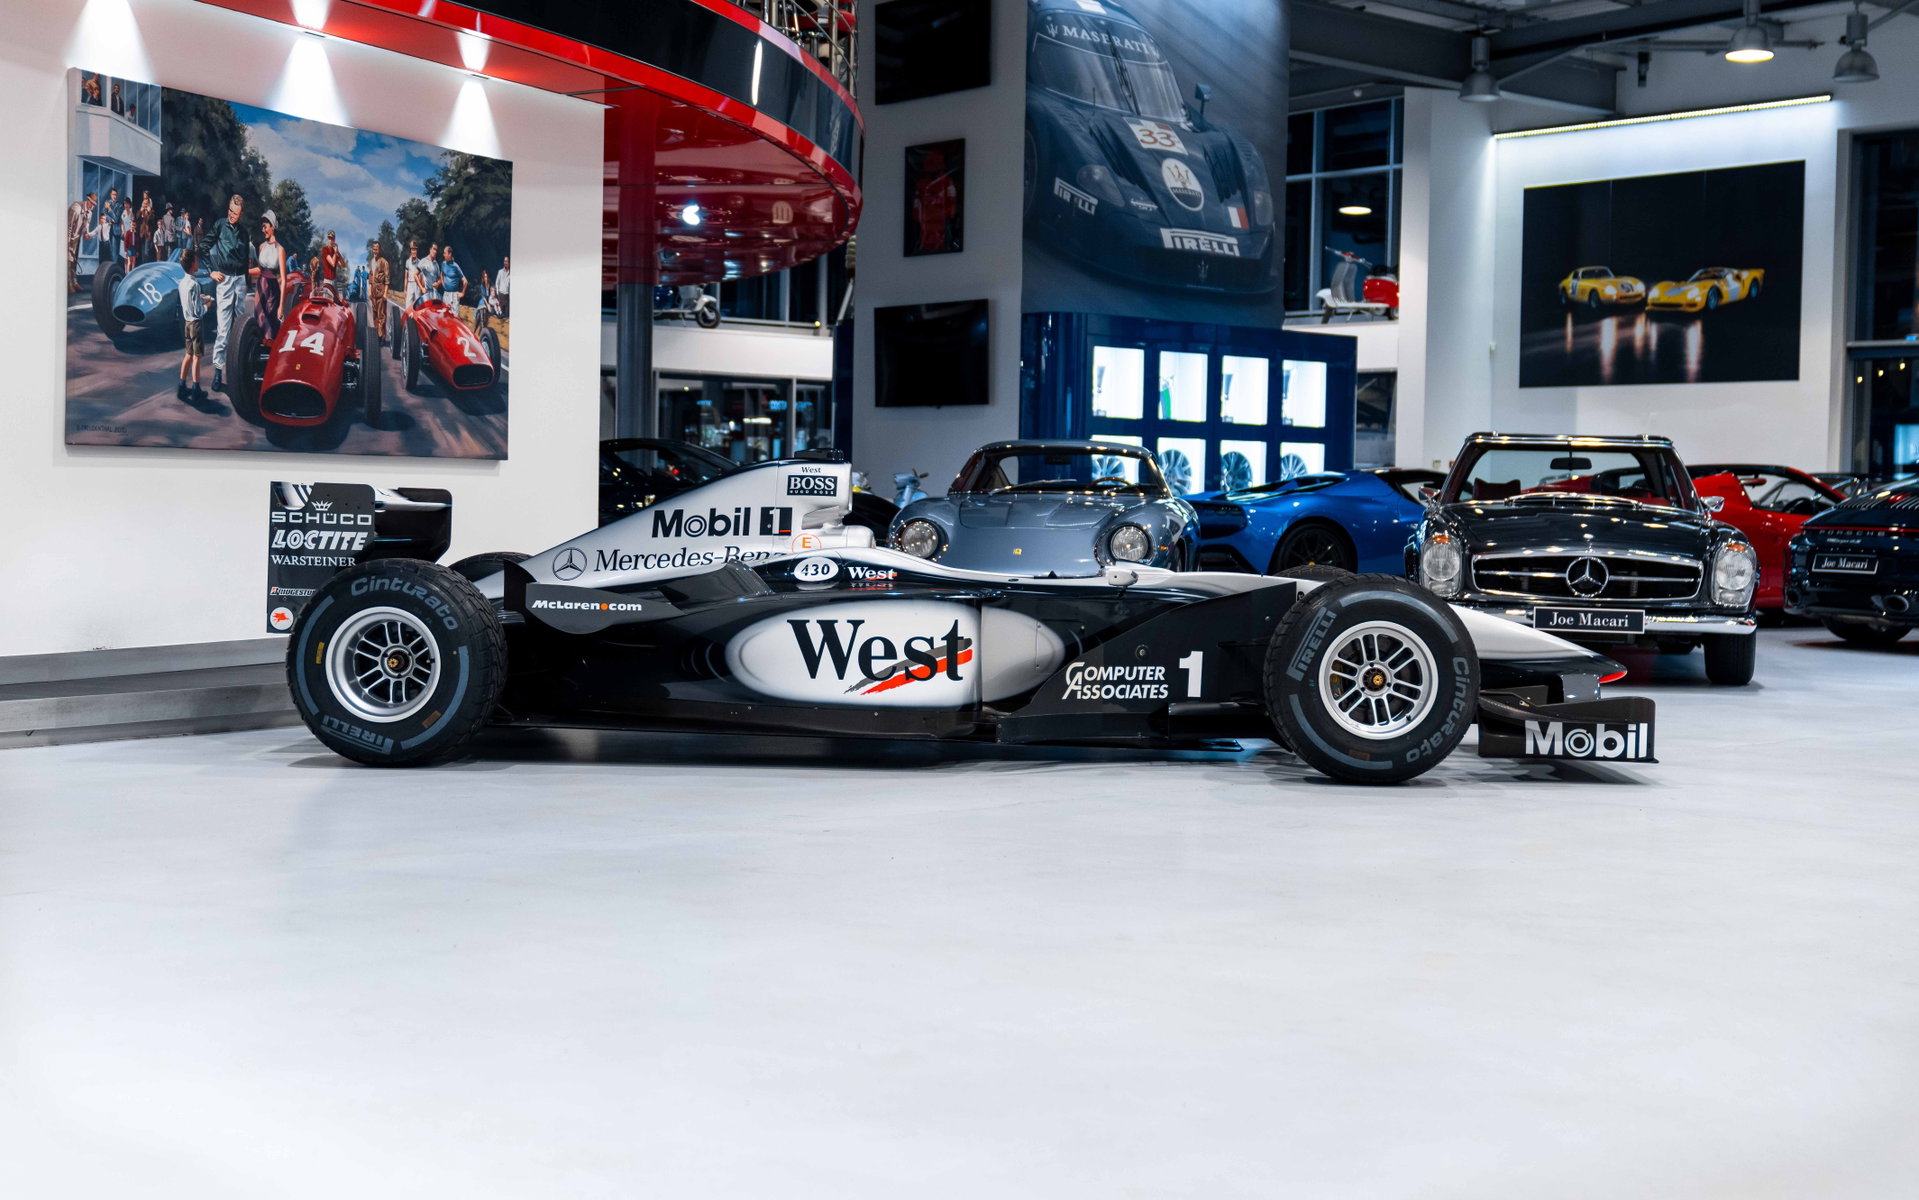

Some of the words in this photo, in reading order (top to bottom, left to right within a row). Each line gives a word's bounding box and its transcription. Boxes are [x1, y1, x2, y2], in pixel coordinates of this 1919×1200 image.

[1062, 25, 1150, 55] MASERATI
[1138, 129, 1175, 148] 33
[1160, 228, 1241, 257] PIRELLI
[137, 282, 163, 305] 18
[278, 330, 325, 357] 14
[457, 336, 477, 358] 2
[789, 476, 835, 490] BOSS
[271, 511, 372, 526] SCHÜCO
[652, 507, 751, 538] Mobil
[271, 529, 369, 551] LOCTITE
[802, 537, 813, 549] E
[270, 554, 357, 567] WARSTEINER
[801, 564, 831, 577] 430
[847, 566, 895, 580] West
[1821, 557, 1836, 568] Joe
[1837, 557, 1869, 570] Macari
[350, 575, 459, 631] Cinturato
[1549, 611, 1574, 627] Joe
[1578, 612, 1629, 628] Macari
[786, 618, 965, 682] West
[1285, 605, 1338, 682] PIRELLI
[1061, 671, 1169, 700] ASSOCIATES
[1065, 661, 1166, 686] COMPUTER
[1179, 650, 1204, 698] 1
[1405, 656, 1470, 763] Cinturato
[319, 714, 395, 756] PIRELLI
[1524, 719, 1649, 759] Mobil
